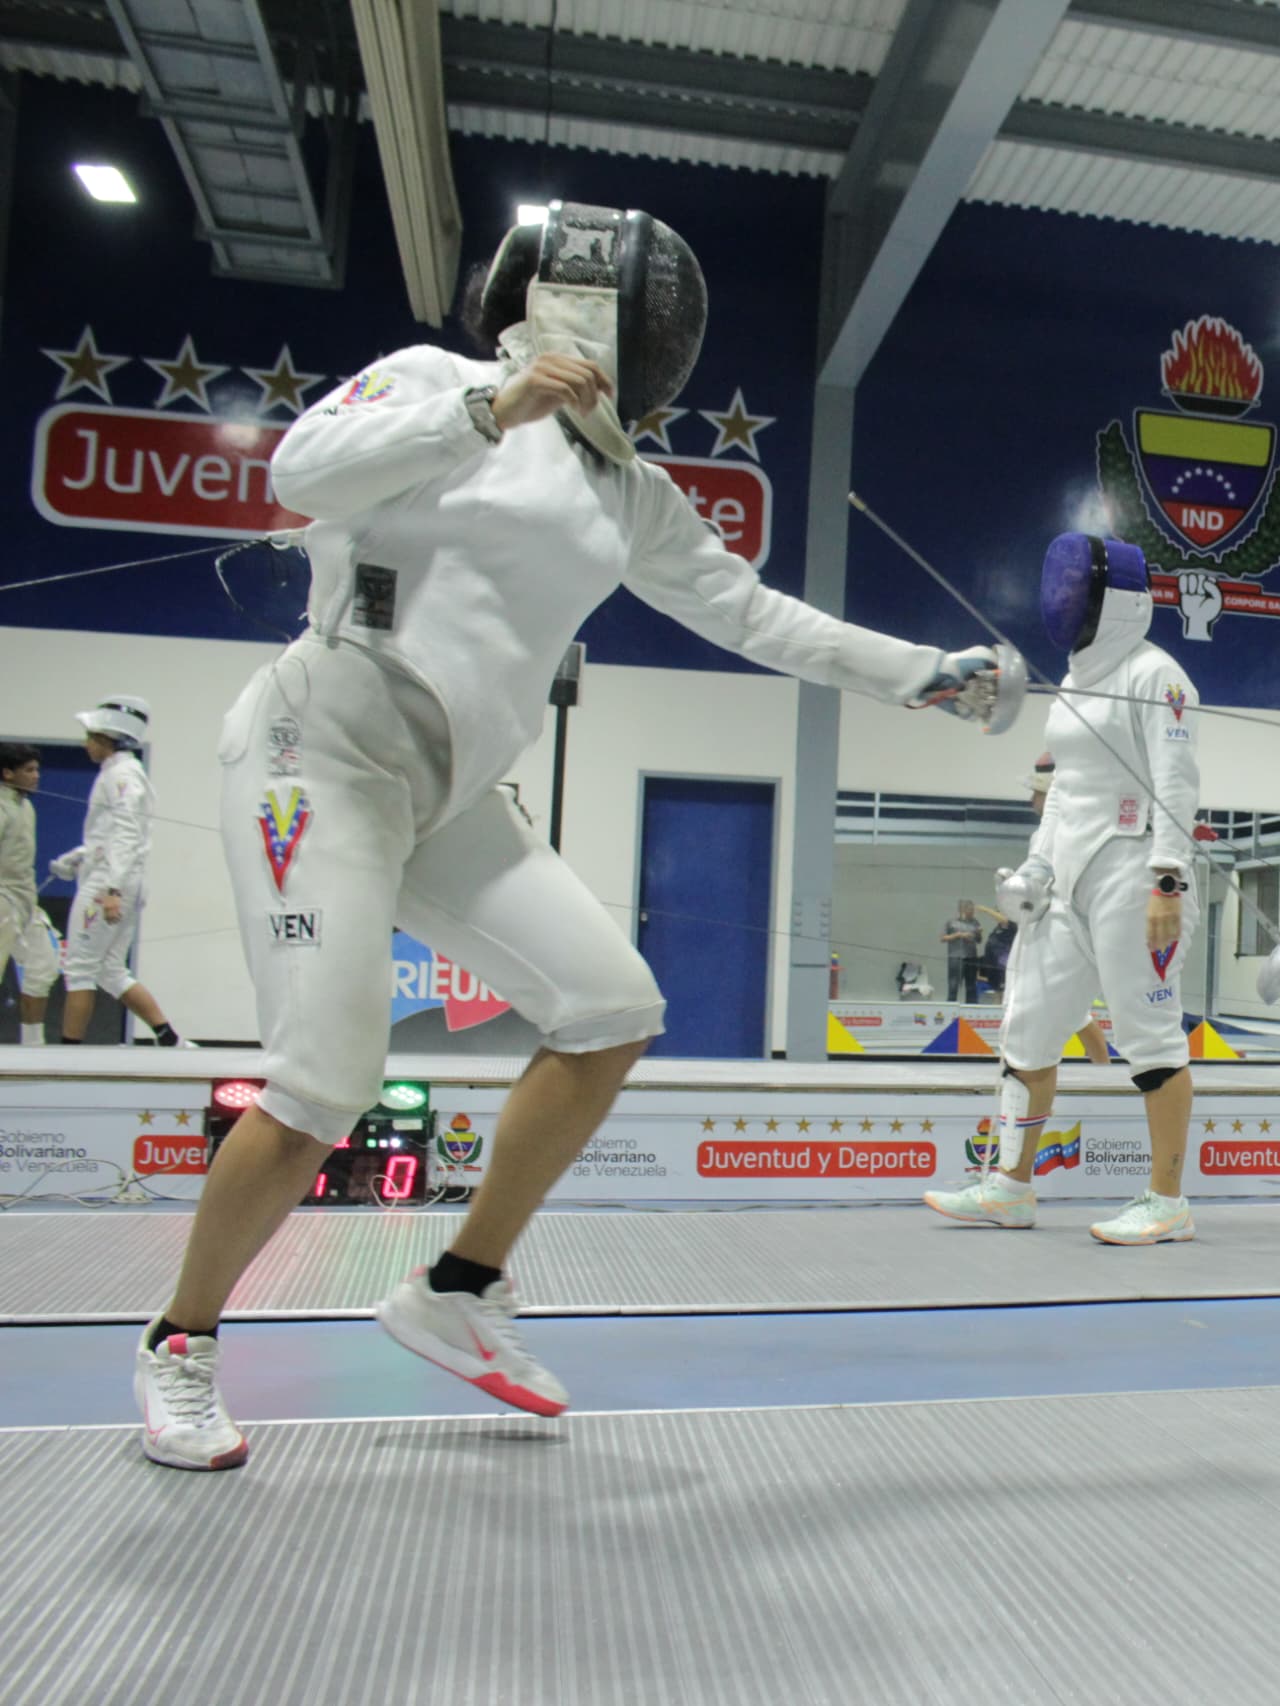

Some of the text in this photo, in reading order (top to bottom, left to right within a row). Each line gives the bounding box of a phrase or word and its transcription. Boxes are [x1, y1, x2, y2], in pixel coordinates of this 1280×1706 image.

[1181, 507, 1225, 532] IND
[1223, 595, 1267, 609] CORPORE
[1166, 727, 1190, 739] VEN
[269, 913, 316, 940] VEN
[1145, 985, 1174, 1004] VEN
[1085, 1138, 1143, 1151] Gobierno
[702, 1146, 931, 1174] Juventud y Deporte
[1085, 1151, 1152, 1163] Bolivarian
[18, 1160, 99, 1173] Venezuela
[572, 1164, 667, 1177] de Venezuela
[1085, 1165, 1101, 1176] de
[381, 1154, 419, 1200] 0
